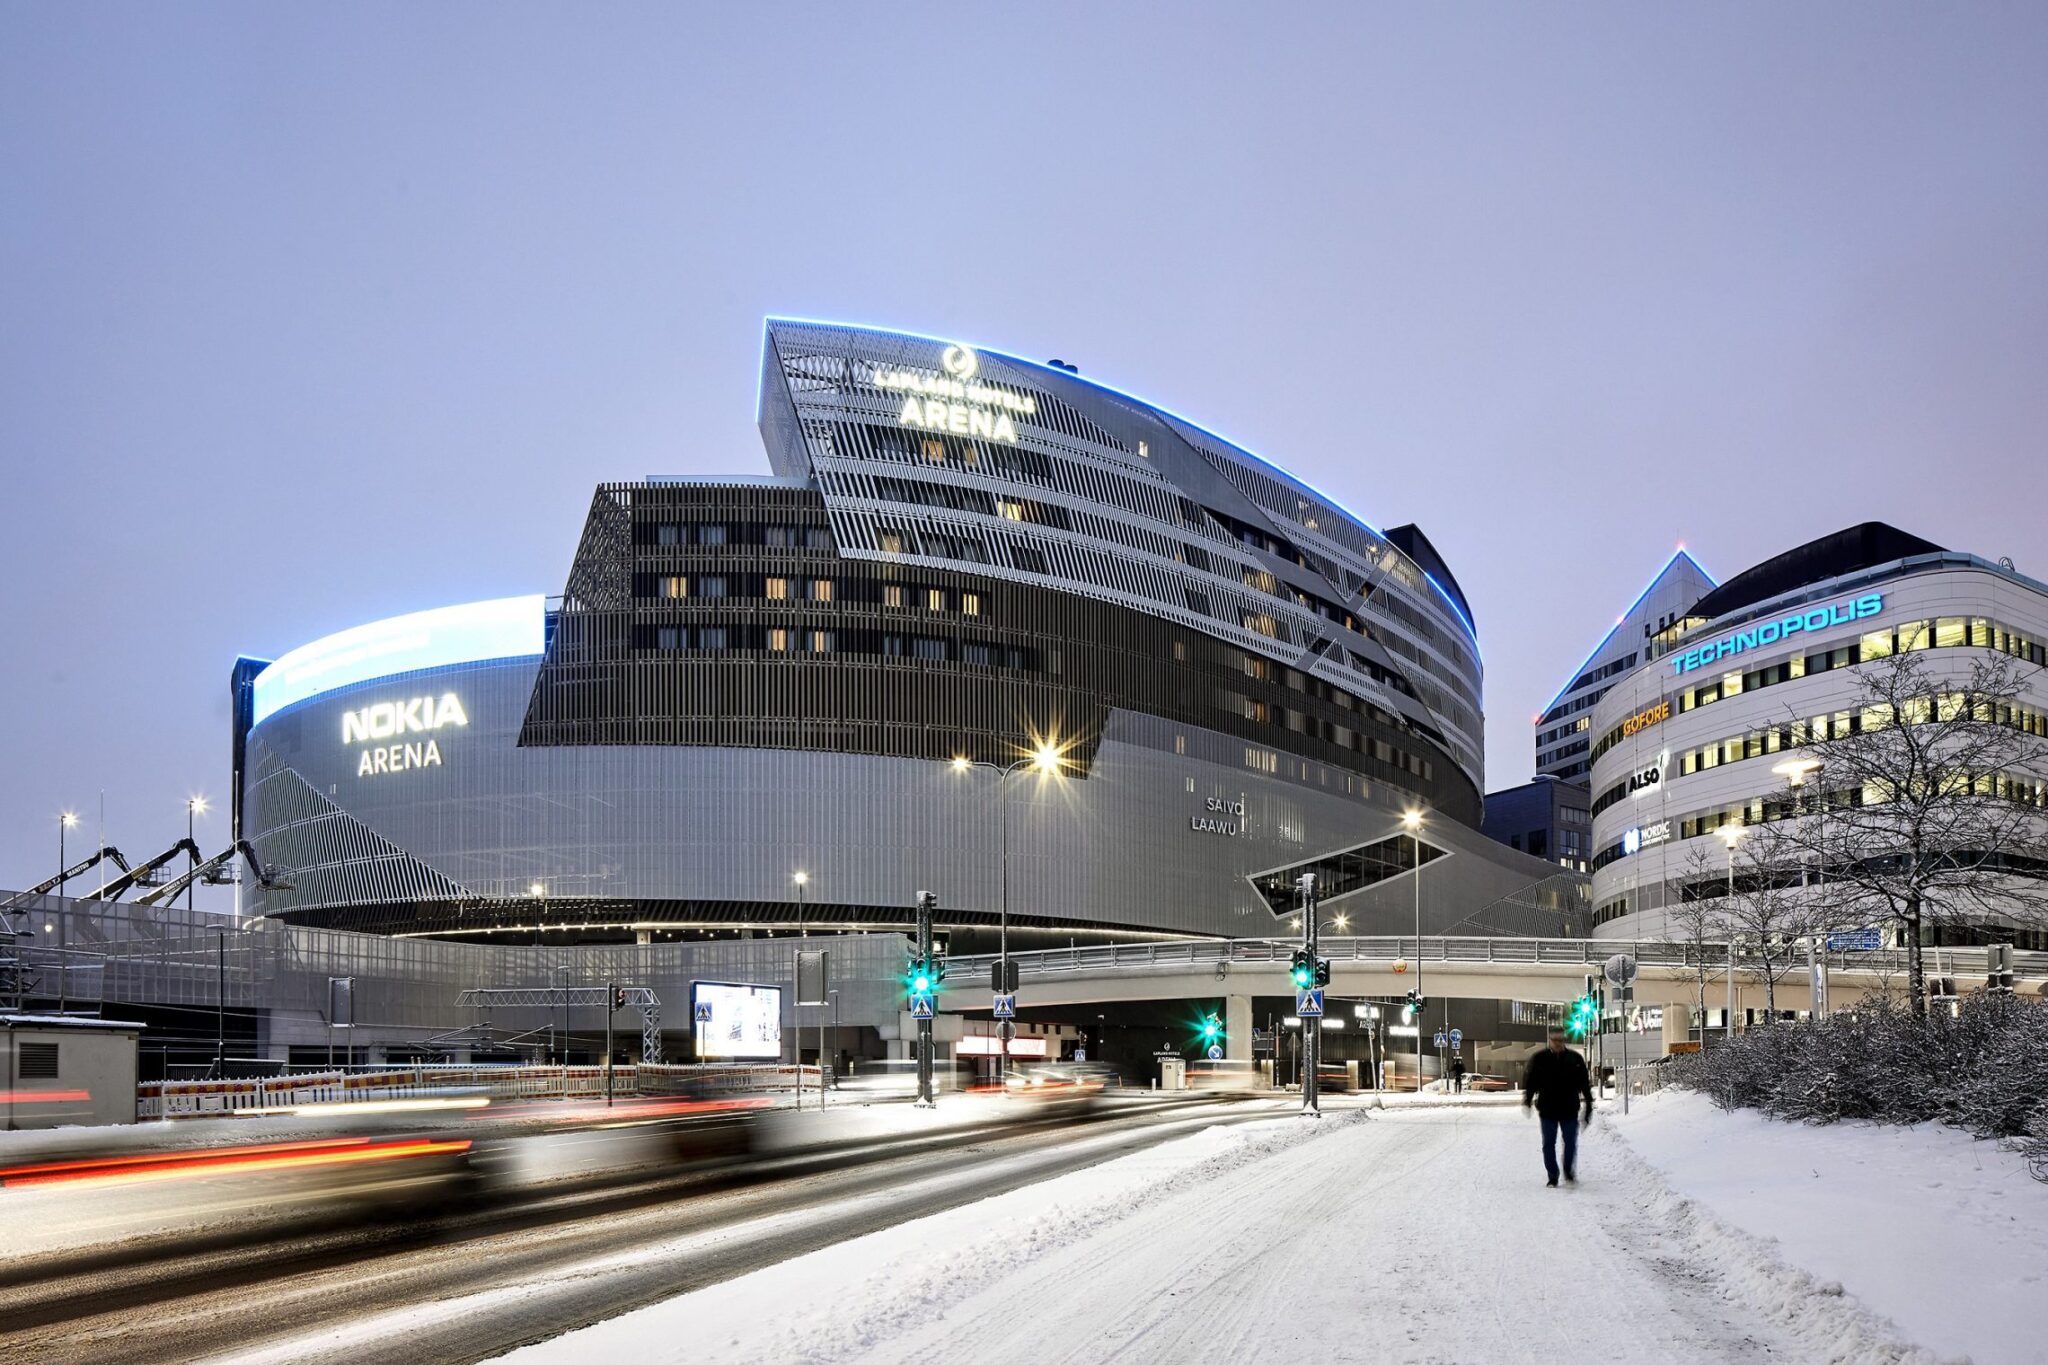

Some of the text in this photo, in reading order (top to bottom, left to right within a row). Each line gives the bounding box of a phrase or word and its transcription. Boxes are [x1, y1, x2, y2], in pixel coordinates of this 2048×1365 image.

[900, 397, 1016, 443] ARENA
[1671, 592, 1883, 675] TECHNOPOLIS
[342, 693, 468, 744] NOKIA
[1623, 702, 1669, 736] GOFORE
[358, 739, 441, 777] ARENA
[1629, 767, 1660, 793] ALSO
[1207, 797, 1244, 816] SAIVO
[1191, 816, 1236, 836] LAAWU
[1641, 821, 1671, 839] NORDIC
